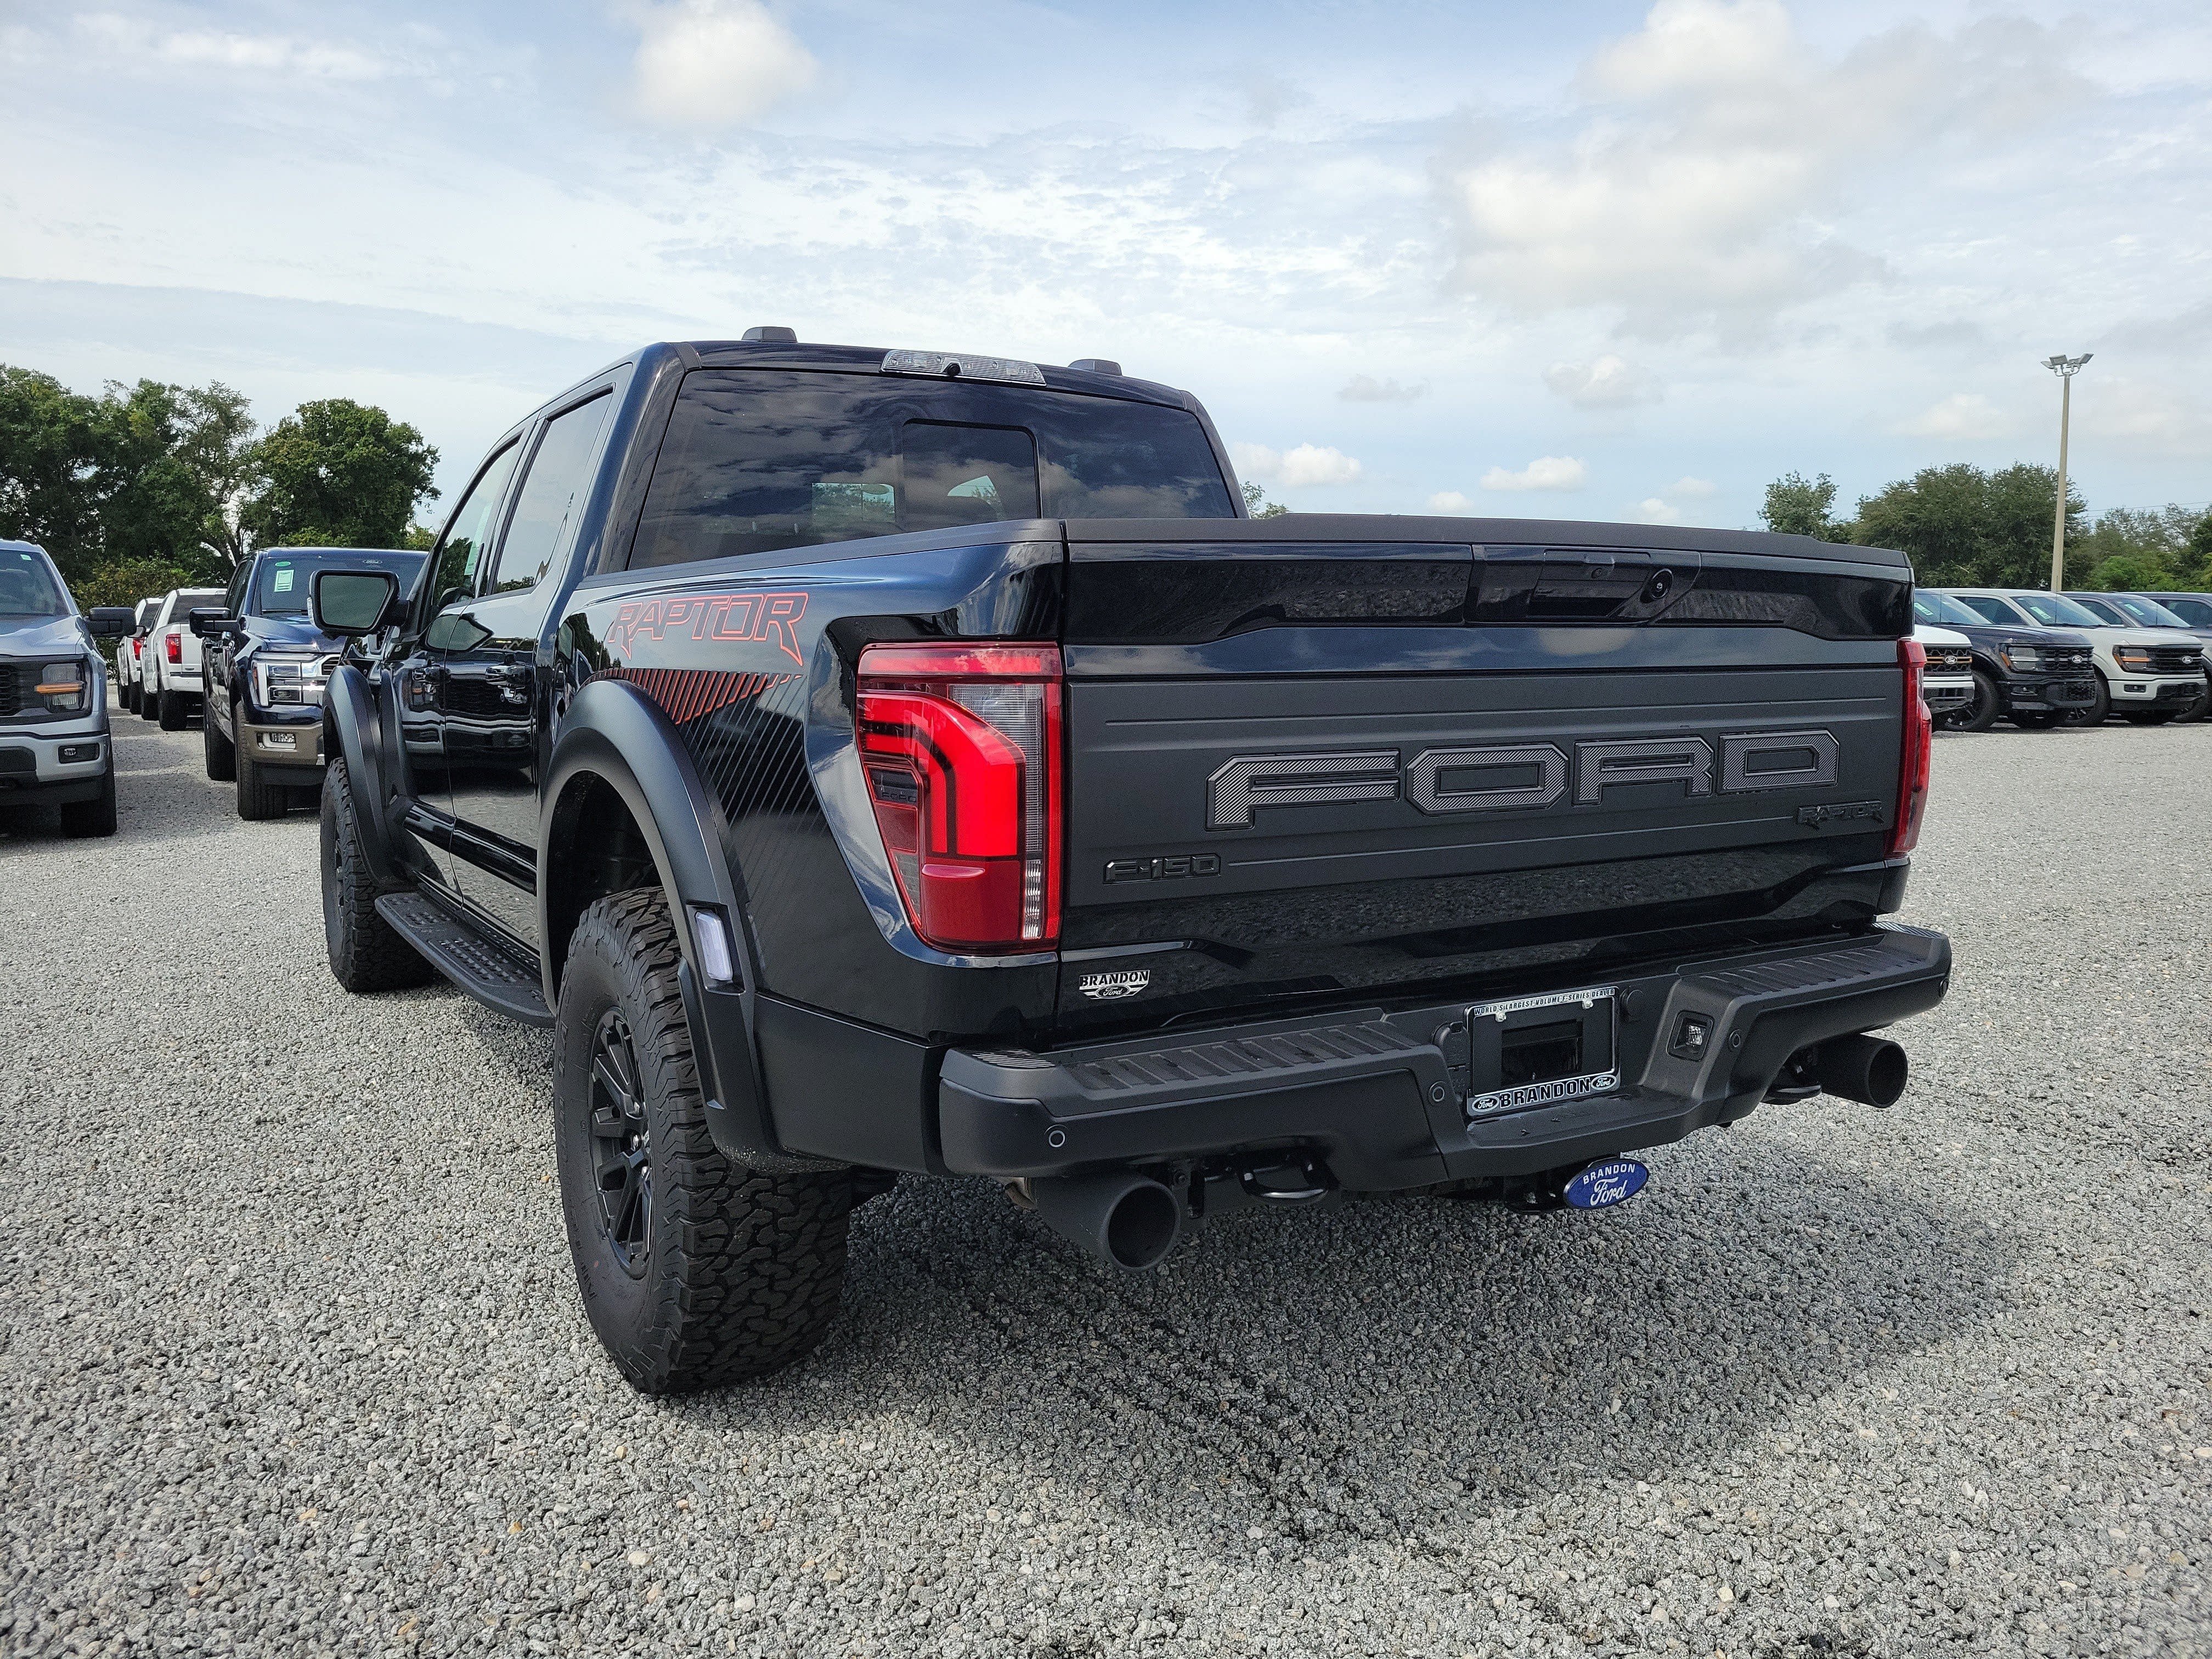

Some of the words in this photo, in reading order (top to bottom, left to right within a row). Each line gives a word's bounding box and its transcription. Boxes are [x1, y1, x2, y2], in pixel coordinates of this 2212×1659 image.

[608, 592, 809, 667] RAPTOR
[1205, 729, 1840, 832] FORD
[1798, 799, 1884, 831] RAPTOR
[1103, 853, 1221, 884] F-150
[1079, 971, 1149, 987] BRANDON
[1103, 987, 1124, 996] Ford
[1474, 1004, 1504, 1015] WORLD'S
[1505, 1000, 1534, 1010] LARGEST
[1536, 996, 1561, 1006] VOLUME
[1562, 992, 1590, 1002] F-SERIES
[1592, 989, 1614, 997] DEALER
[1477, 1098, 1494, 1109] Ford
[1499, 1077, 1591, 1109] BRANDON
[1595, 1078, 1612, 1087] Ford
[1583, 1164, 1635, 1185] BRANDON
[1590, 1176, 1628, 1206] Ford
